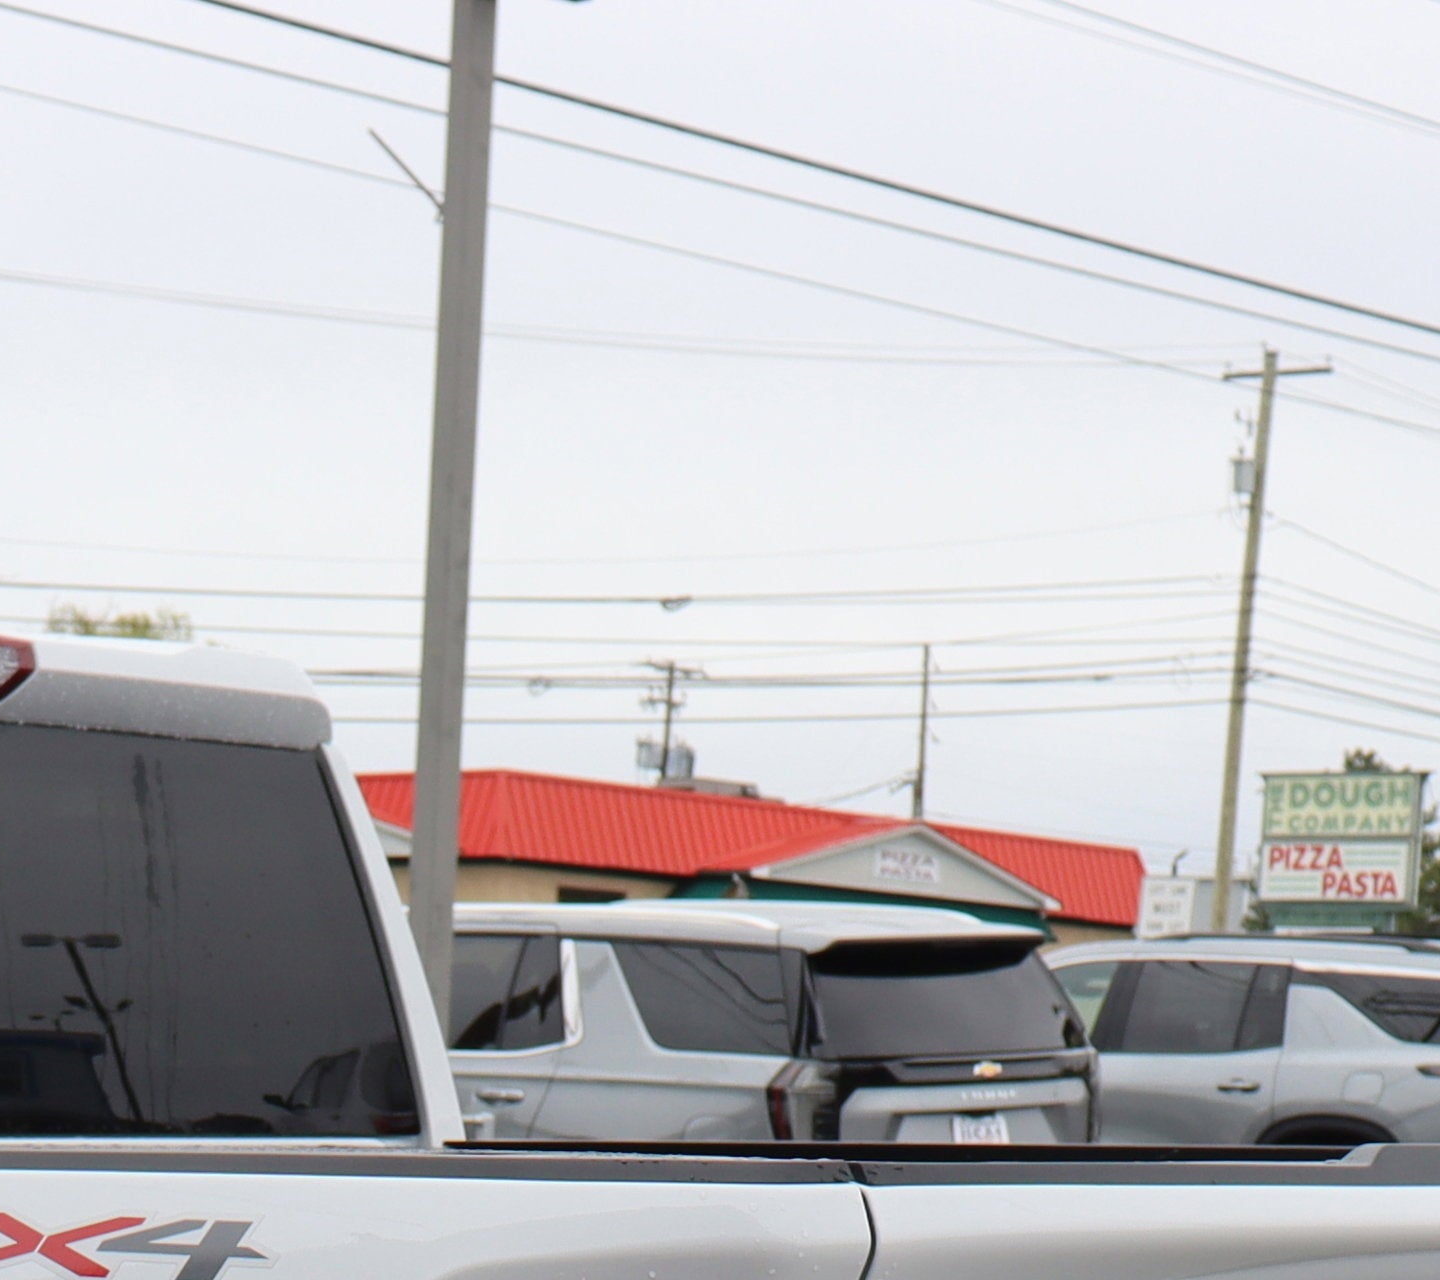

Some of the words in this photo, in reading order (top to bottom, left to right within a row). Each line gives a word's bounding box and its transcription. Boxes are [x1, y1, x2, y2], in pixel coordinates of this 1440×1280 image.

[1289, 782, 1411, 808] DOUGH
[1288, 815, 1409, 831] COMPANY
[1268, 843, 1344, 871] PIZZA
[1321, 871, 1398, 897] PASTA
